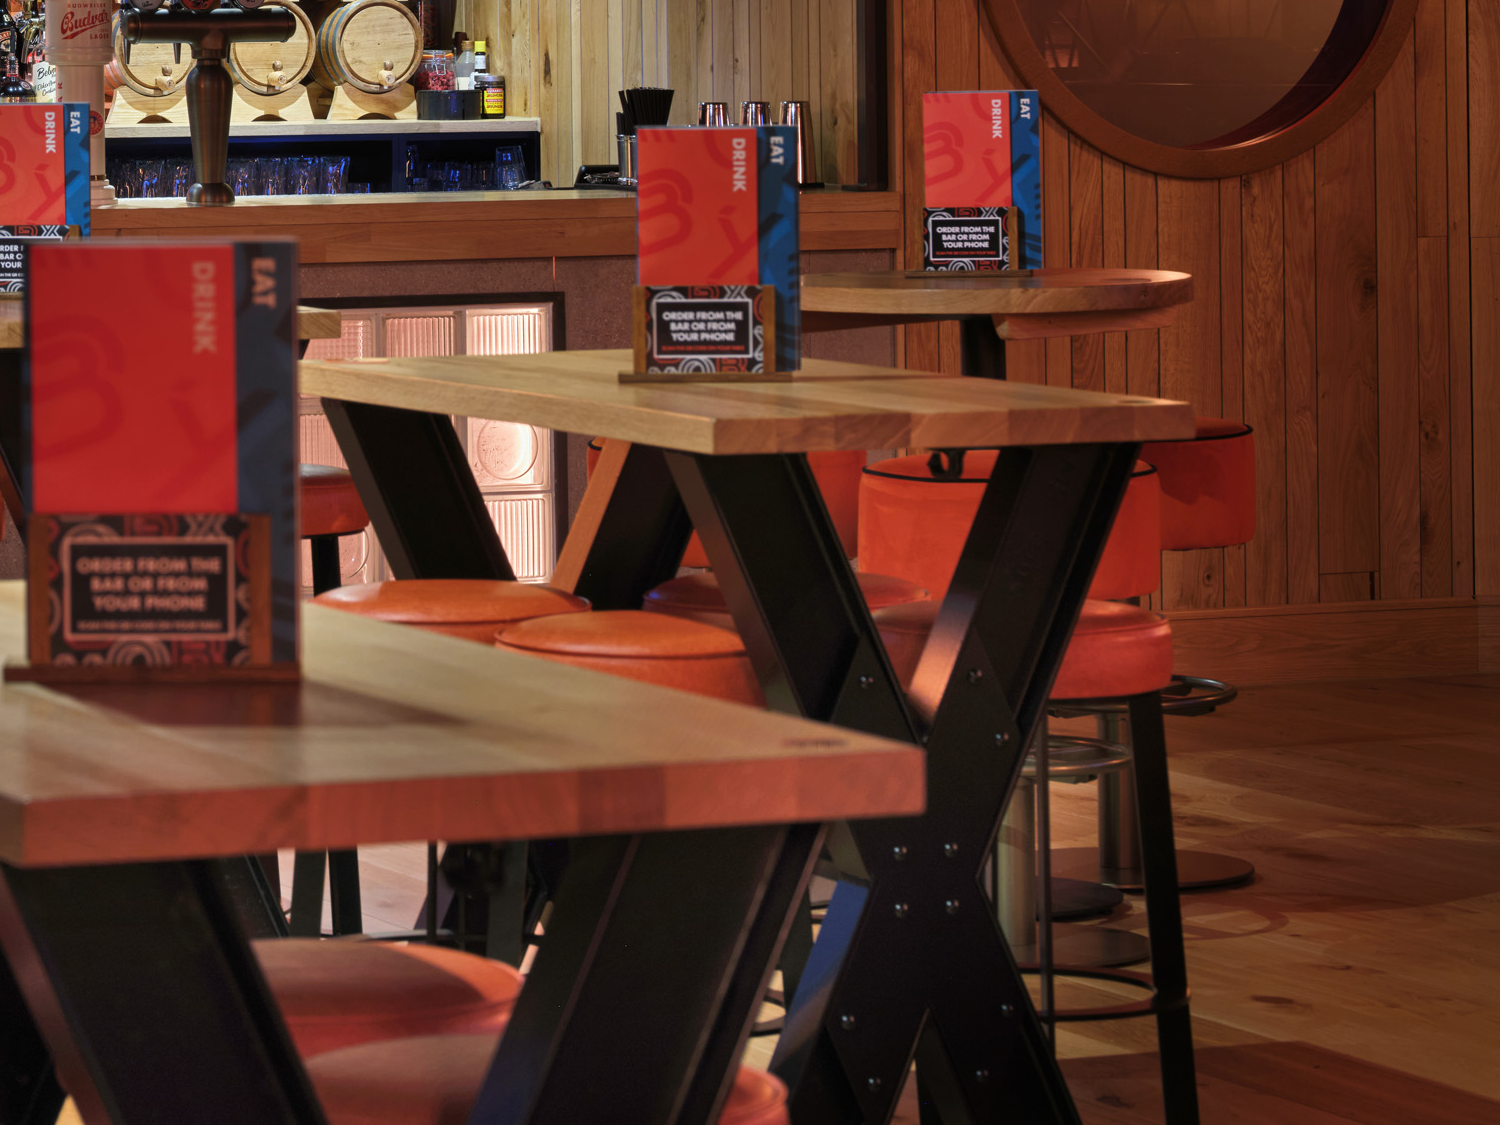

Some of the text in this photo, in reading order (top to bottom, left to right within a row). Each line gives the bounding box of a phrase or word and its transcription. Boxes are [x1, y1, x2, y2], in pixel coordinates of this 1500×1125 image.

[70, 111, 80, 134] EAT
[991, 99, 1002, 139] DRINK
[1020, 98, 1030, 119] EAT
[45, 111, 56, 153] DRINK
[732, 138, 747, 192] DRINK
[770, 136, 784, 165] EAT
[251, 257, 276, 308] EAT
[192, 261, 217, 355] DRINK
[662, 311, 743, 321] ORDER FROM THE
[670, 322, 736, 331] BAR OR FROM
[671, 332, 735, 342] YOUR PHONE
